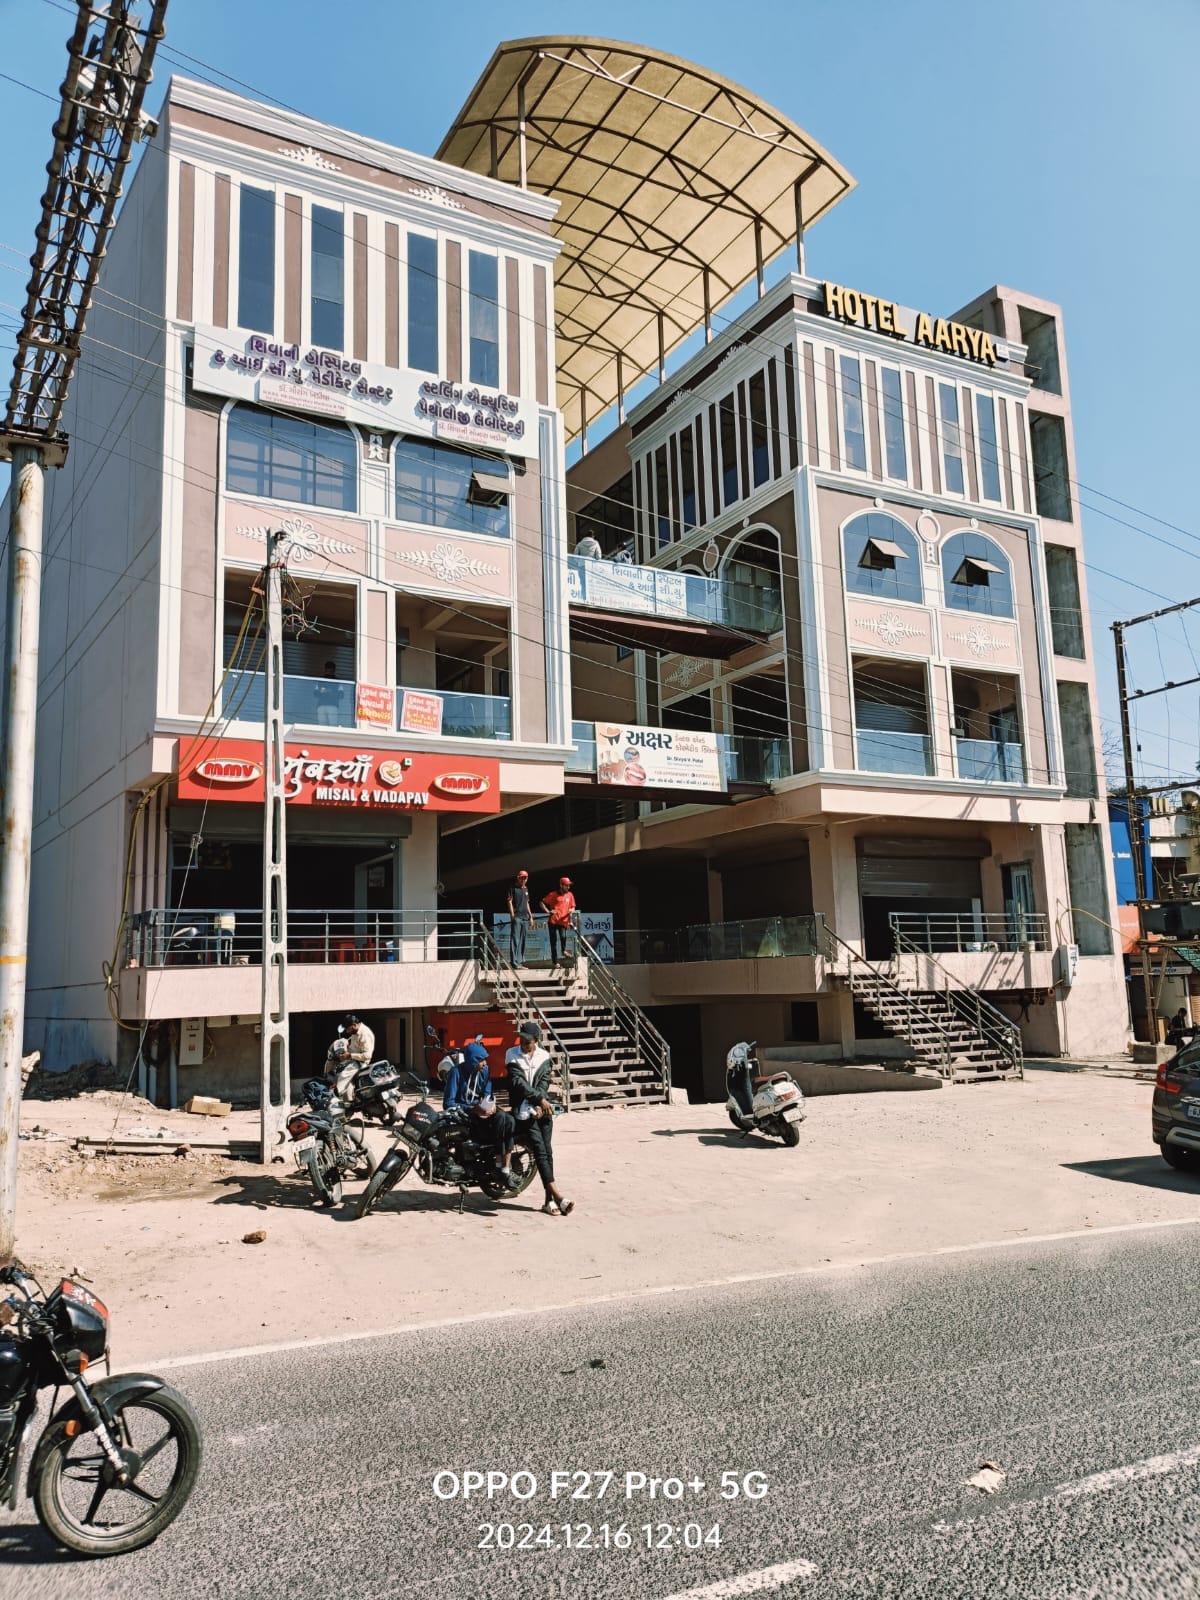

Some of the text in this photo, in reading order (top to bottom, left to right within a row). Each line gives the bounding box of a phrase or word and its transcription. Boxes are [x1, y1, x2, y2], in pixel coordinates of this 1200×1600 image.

[825, 281, 996, 363] HOTEL AARYA
[250, 335, 362, 377] શિવાની હોસ્પિટલ
[214, 349, 226, 363] &
[311, 367, 352, 392] મેડીકેર
[356, 377, 394, 401] સેન્ટર
[474, 409, 525, 436] લેબોરેટરી
[625, 730, 672, 750] અક્ષર
[204, 762, 254, 777] mmv
[440, 777, 483, 791] mmv
[315, 787, 430, 805] MISAL & VADAPAV
